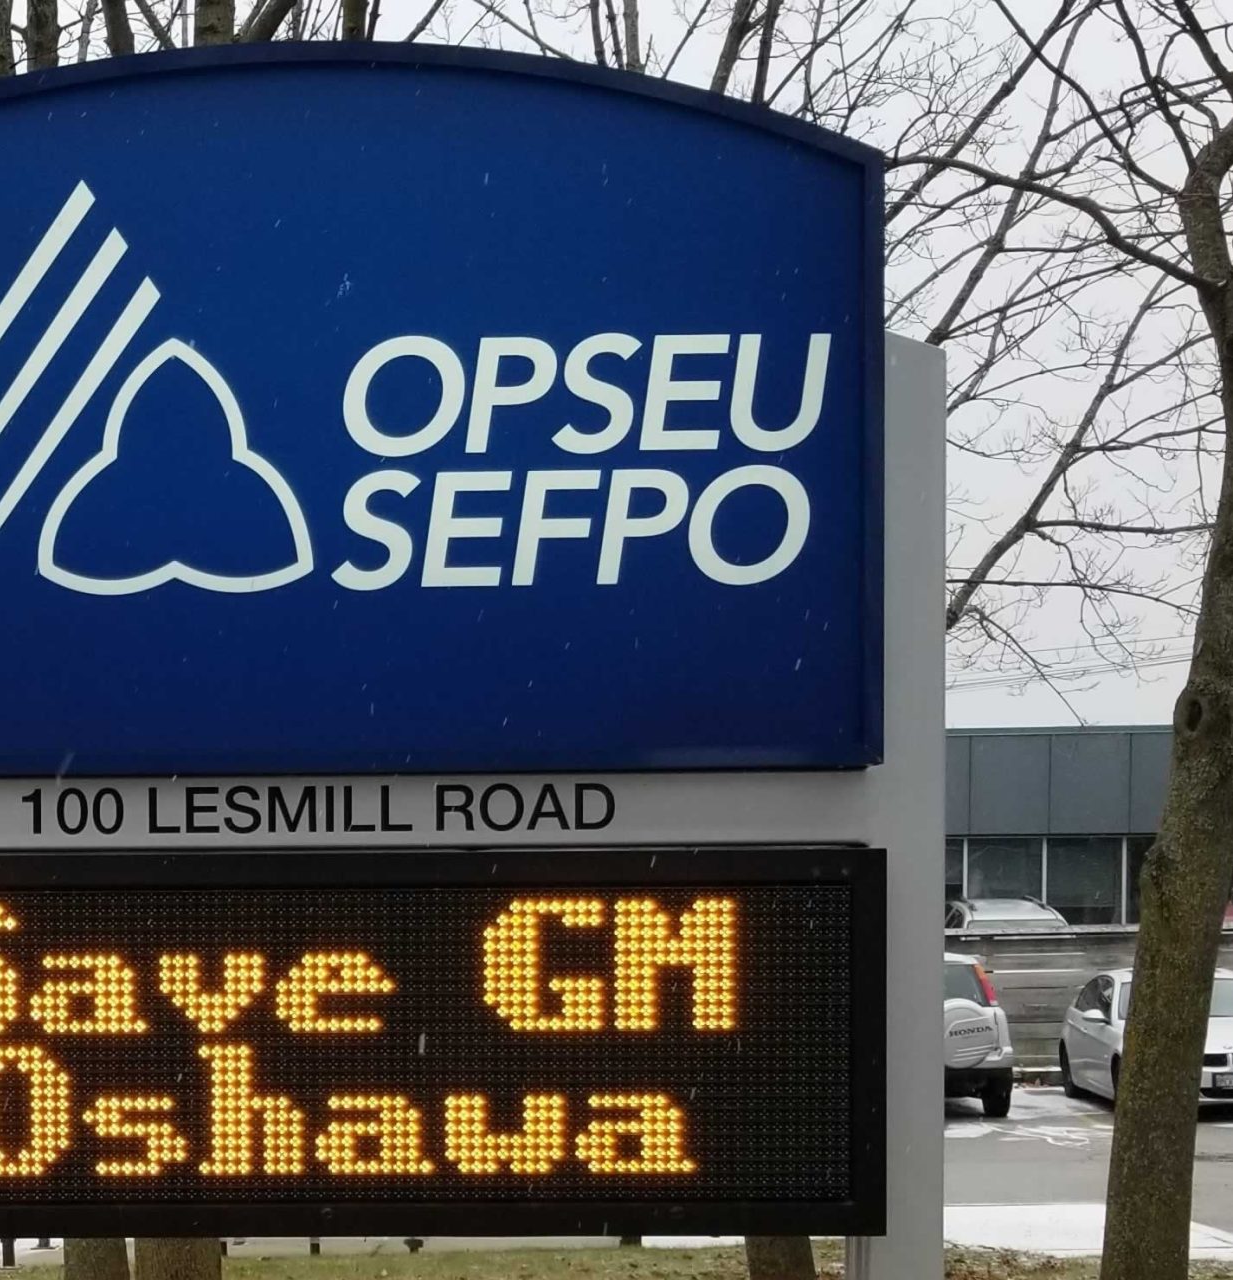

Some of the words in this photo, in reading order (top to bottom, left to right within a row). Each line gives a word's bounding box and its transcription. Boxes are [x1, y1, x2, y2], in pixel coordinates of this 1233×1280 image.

[343, 333, 832, 457] OPSEU
[330, 464, 810, 591] SEFPO
[21, 787, 124, 835] 100
[148, 785, 413, 834] LESMILL
[434, 783, 616, 832] ROAD
[483, 898, 736, 1032] GM
[948, 1025, 993, 1037] HONDA
